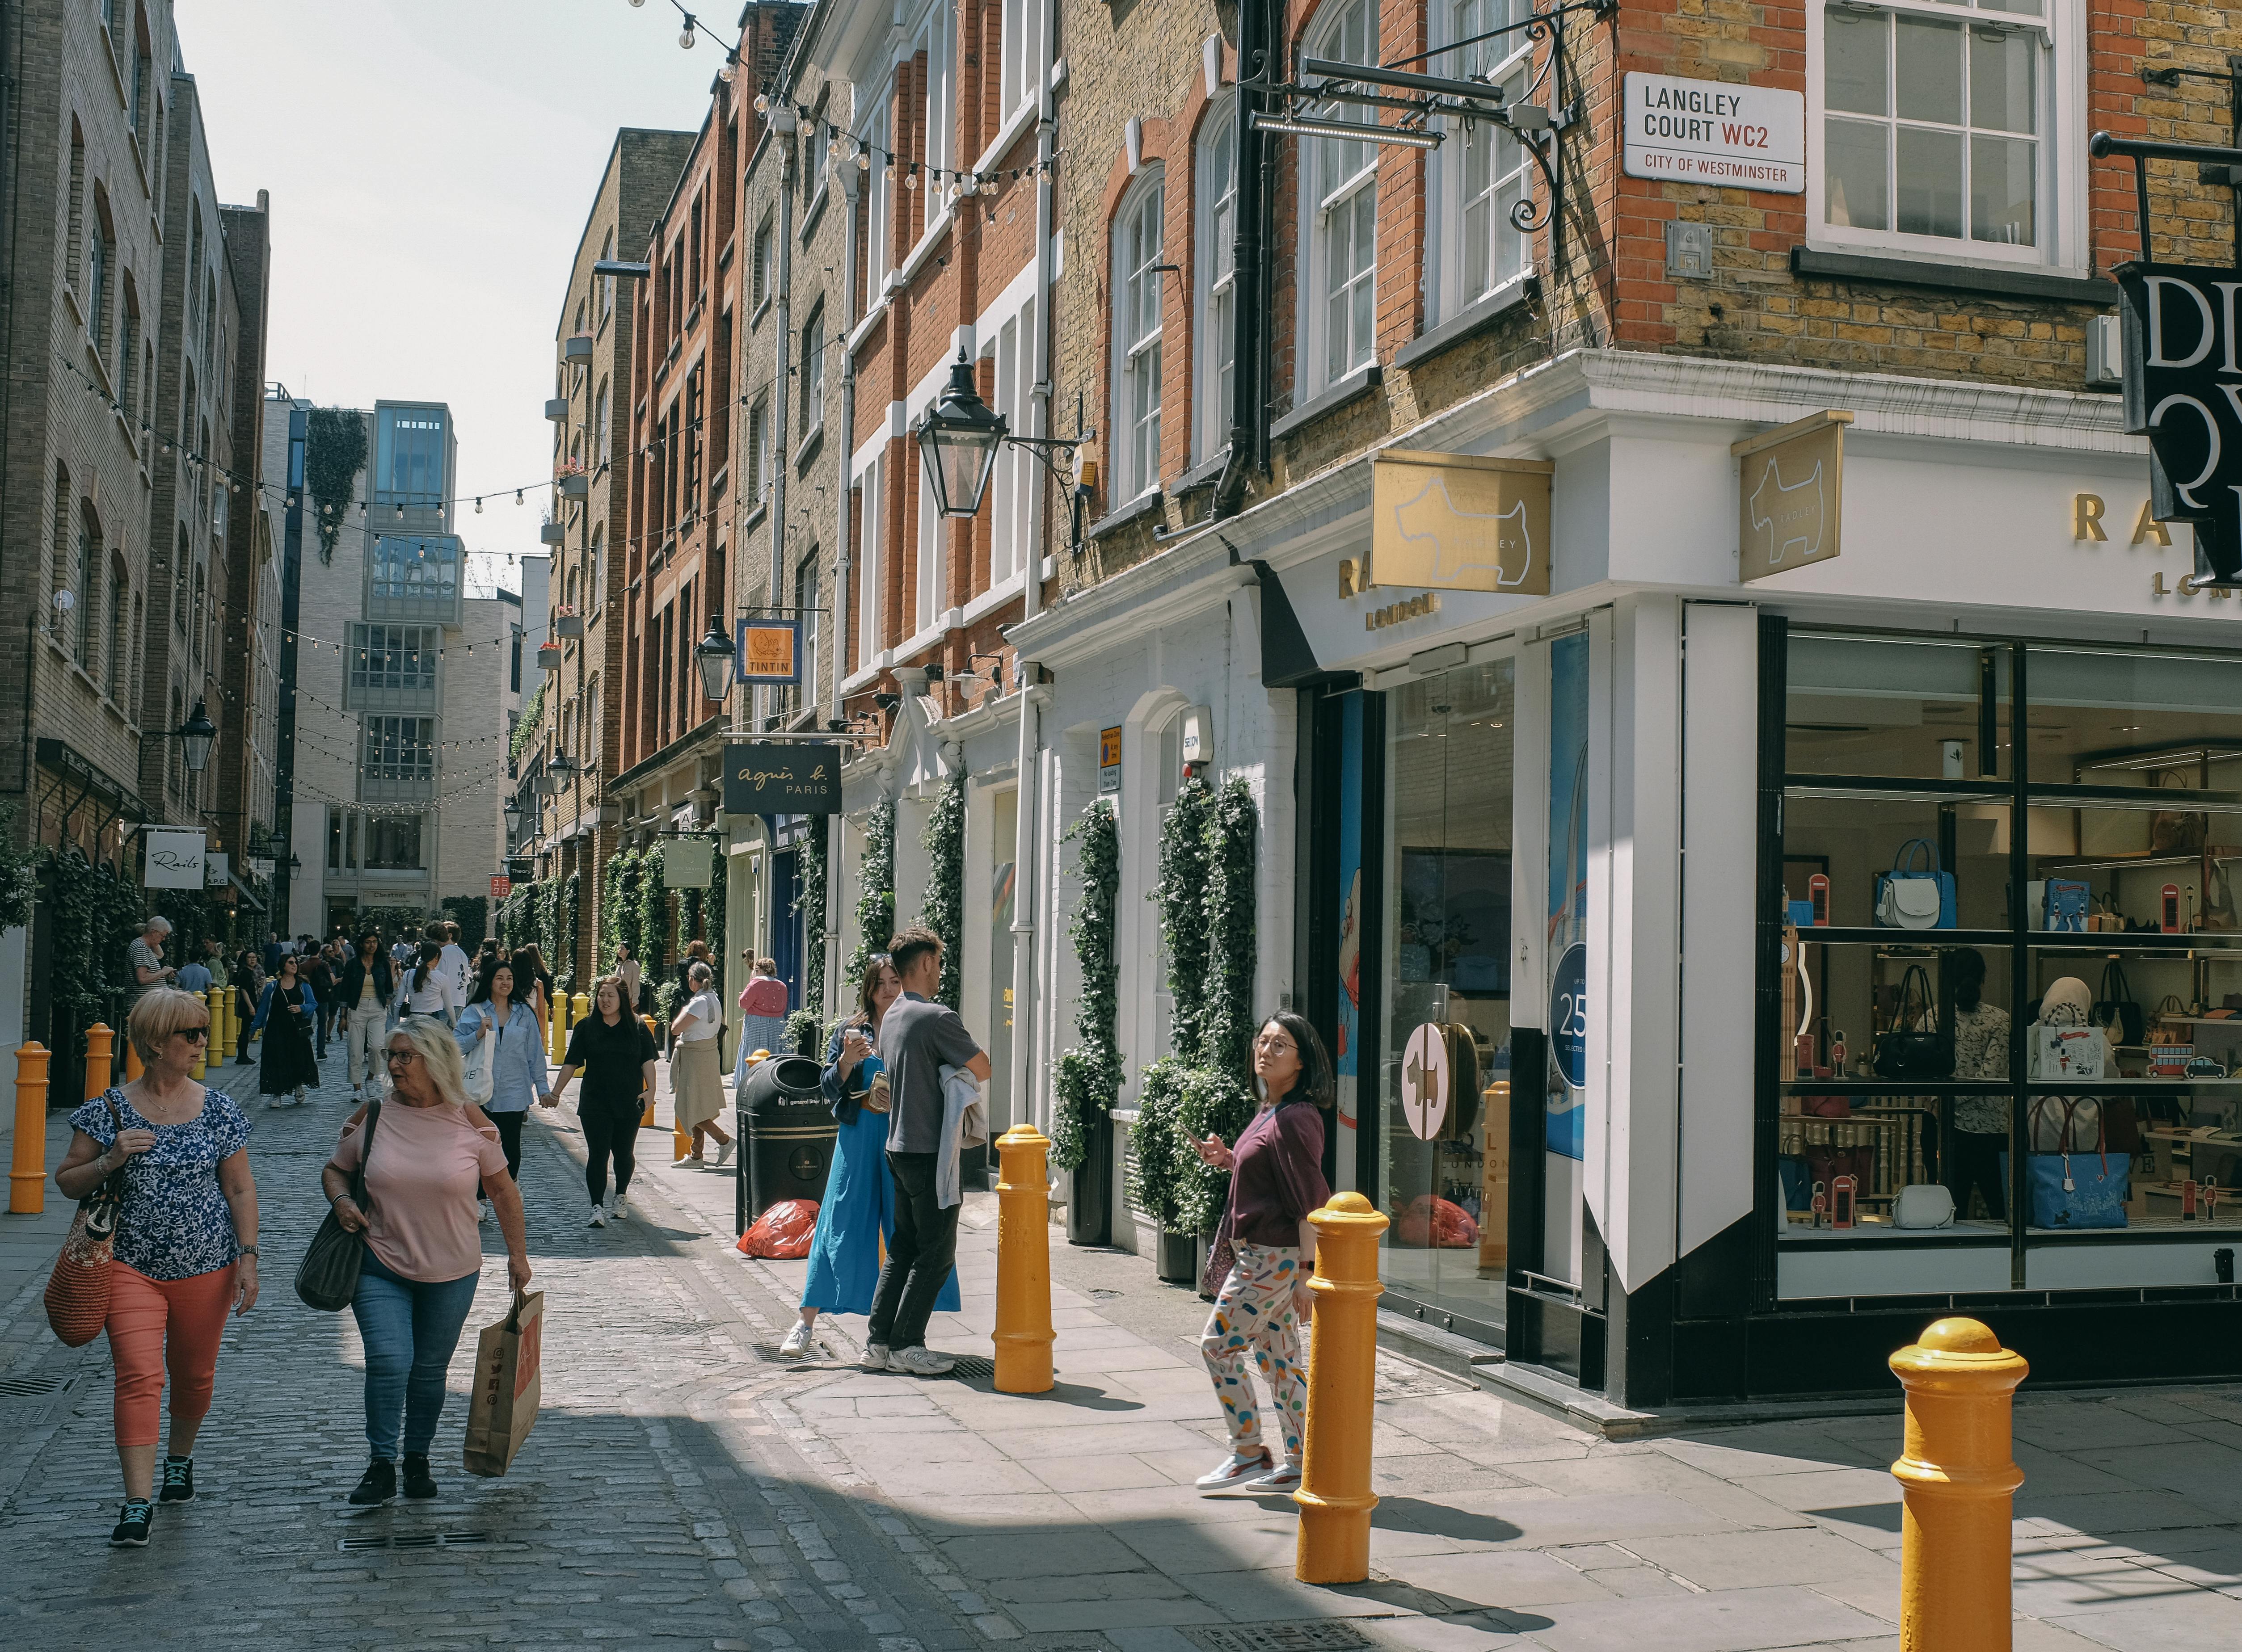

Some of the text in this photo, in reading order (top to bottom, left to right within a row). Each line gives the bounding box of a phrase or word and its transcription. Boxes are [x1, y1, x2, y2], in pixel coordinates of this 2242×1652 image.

[1645, 85, 1741, 117] LANGLEY
[1644, 114, 1768, 148] COURT WC2
[1645, 154, 1787, 182] CITY OF WESTMINSTER
[1685, 231, 1692, 243] 6
[1781, 504, 1816, 523] RADLEY
[1365, 592, 1435, 631] LONDON
[749, 661, 789, 673] TINTIN
[738, 765, 828, 791] agnès b.
[1108, 769, 1116, 777] loading
[786, 785, 827, 794] PARIS
[152, 851, 199, 871] Rails
[1559, 993, 1586, 1037] 25
